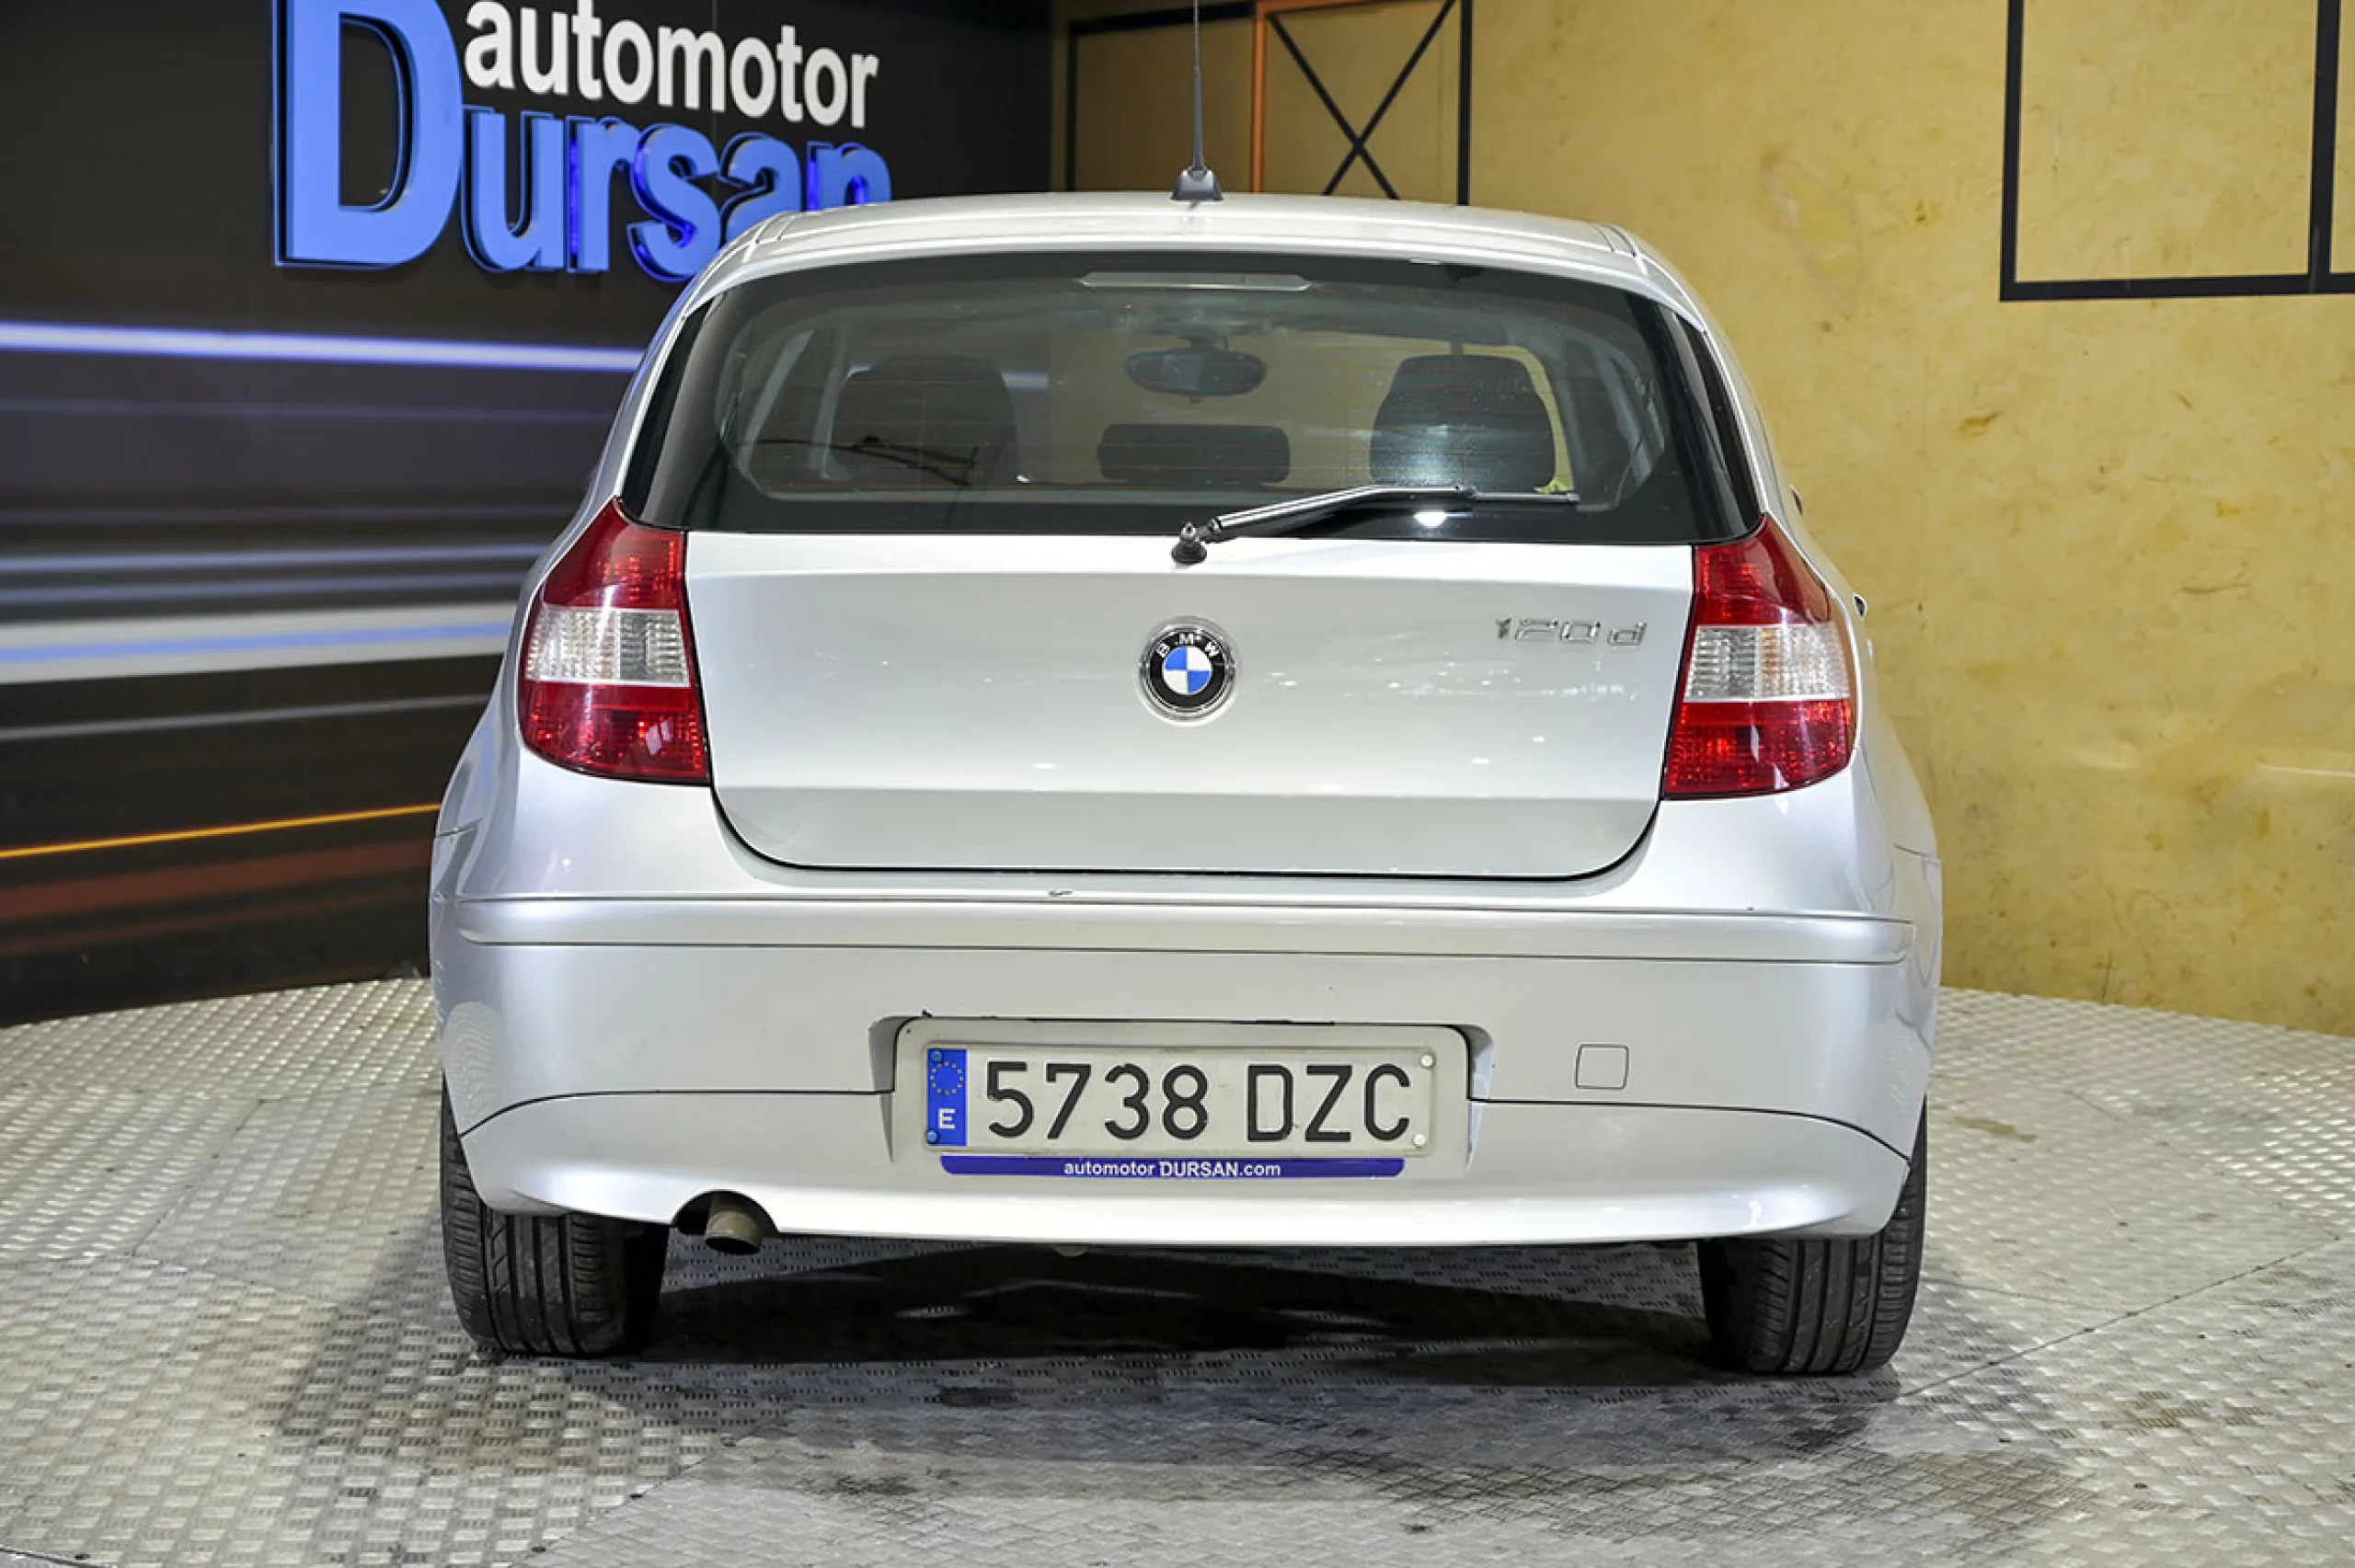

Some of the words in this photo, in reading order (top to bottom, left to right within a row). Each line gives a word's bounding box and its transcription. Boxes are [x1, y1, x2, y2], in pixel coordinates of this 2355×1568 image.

[465, 0, 879, 129] automotor
[1495, 614, 1648, 646] 120d
[985, 1060, 1210, 1139] 5738
[1246, 1063, 1411, 1143] DZC
[937, 1108, 956, 1129] E
[1063, 1161, 1155, 1175] automotor
[1159, 1161, 1281, 1177] DURSAN.com
